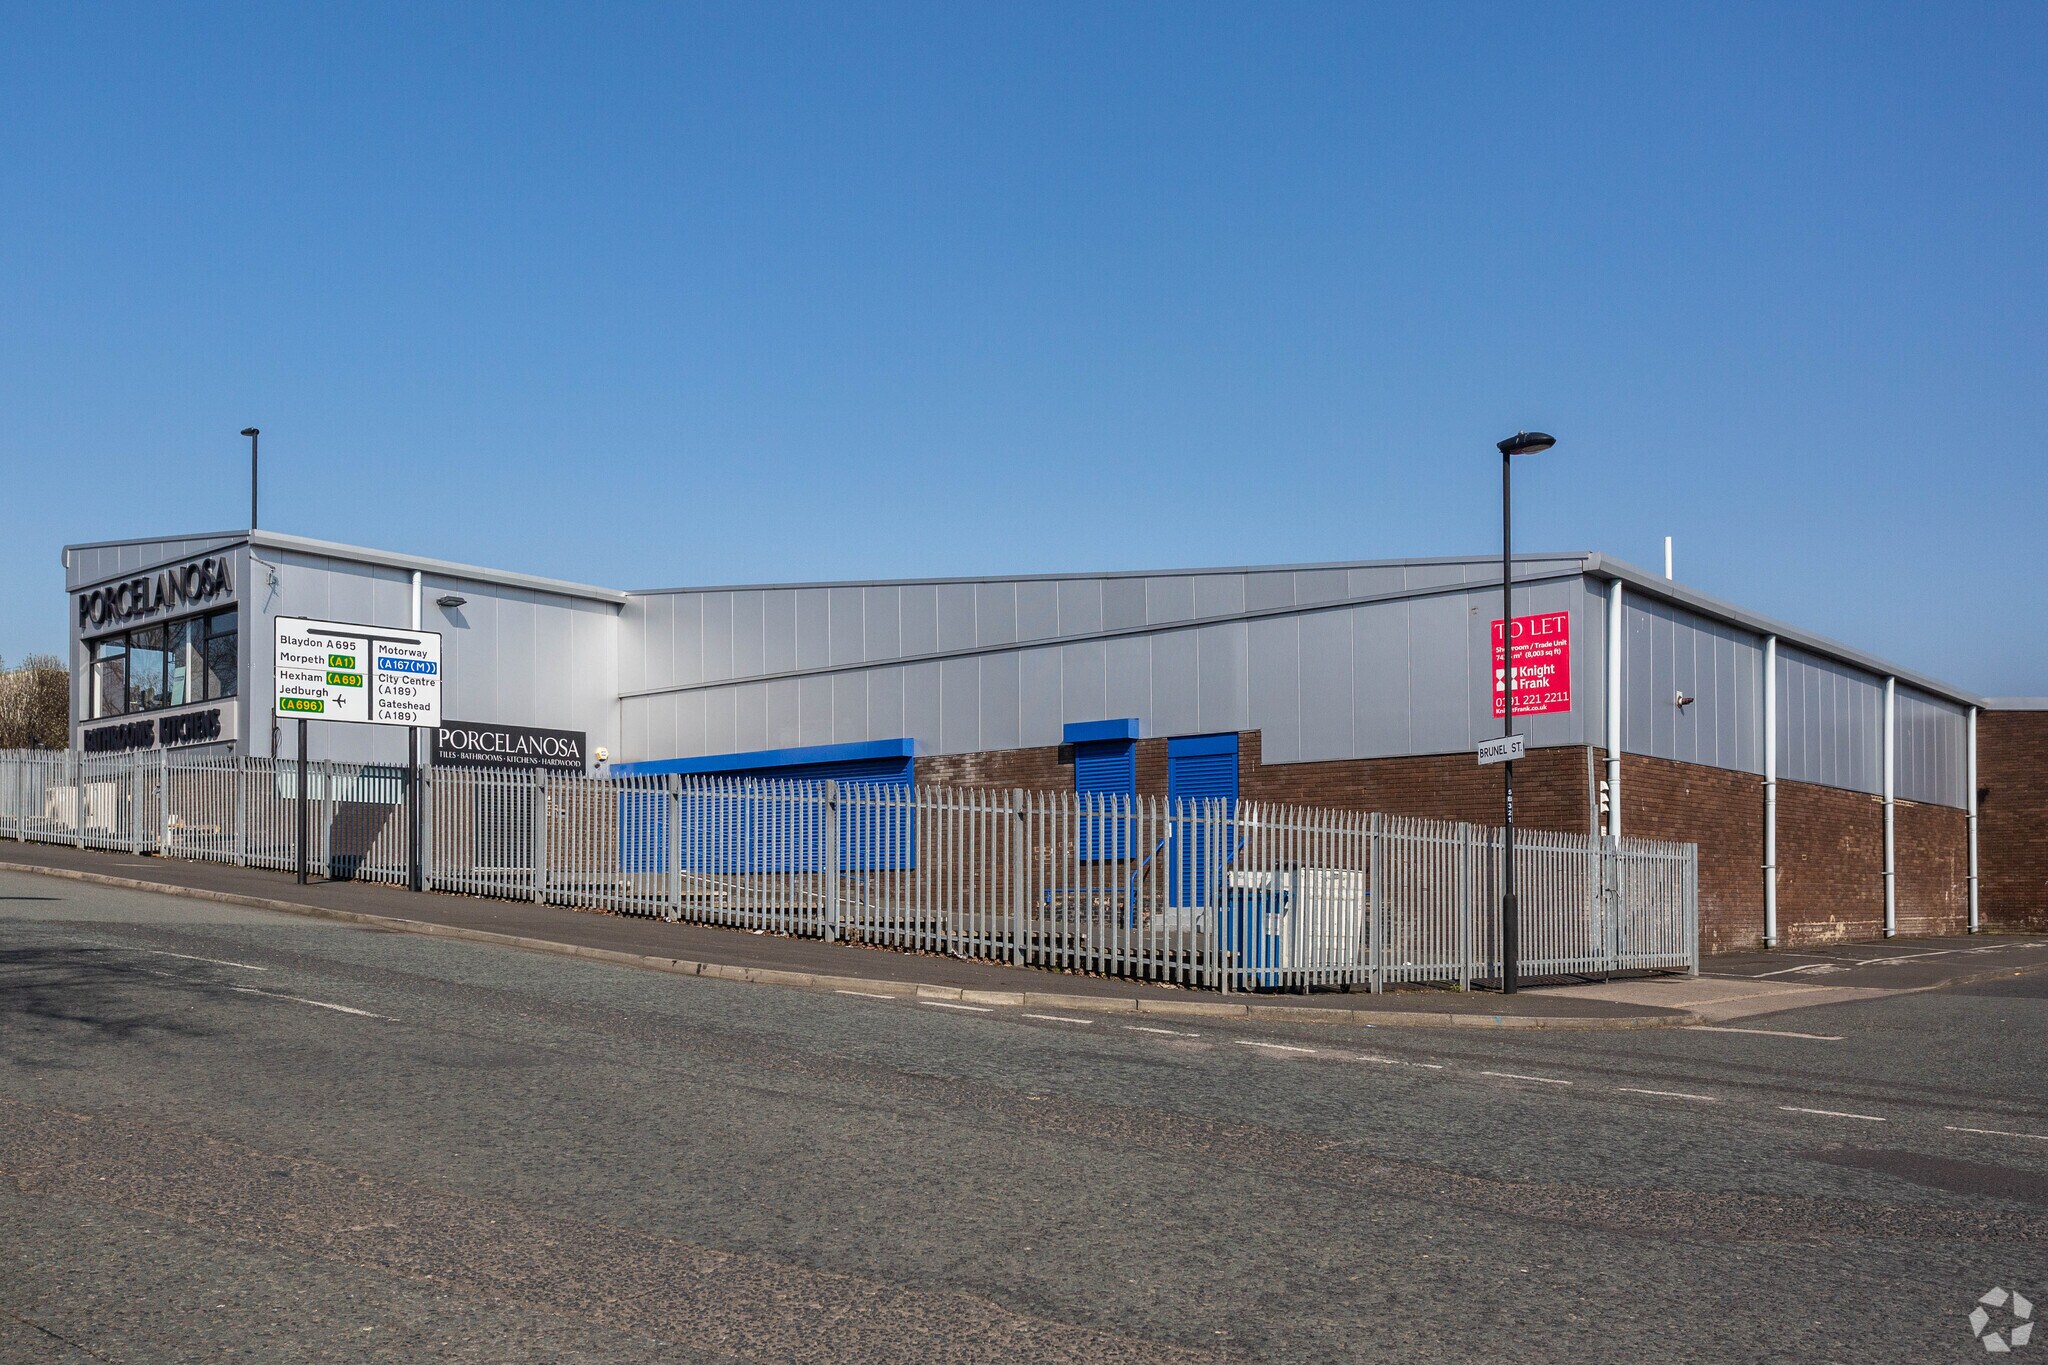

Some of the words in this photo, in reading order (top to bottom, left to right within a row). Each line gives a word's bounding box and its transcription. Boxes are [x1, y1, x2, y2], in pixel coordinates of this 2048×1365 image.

[79, 557, 233, 629] PORCELANOSA
[1494, 622, 1523, 639] TO
[1531, 616, 1566, 636] LET
[280, 636, 322, 648] Blaydon
[379, 645, 427, 658] Motorway
[280, 652, 324, 665] Morpeth
[330, 655, 355, 668] (A1)
[379, 658, 436, 673] (A167(M))
[1520, 664, 1555, 677] Knight
[280, 671, 322, 682] Hexham
[327, 673, 362, 686] (A69)
[379, 674, 399, 685] City
[402, 676, 435, 687] Centre
[1520, 678, 1550, 689] Frank
[280, 685, 328, 698] Jedburgh
[379, 686, 417, 697] (A189)
[1523, 694, 1541, 704] 221
[1545, 692, 1569, 702] 2211
[281, 698, 323, 712] (A696)
[379, 699, 430, 711] Gateshead
[379, 710, 417, 721] (A189)
[159, 709, 221, 745] KITCHENS
[439, 728, 580, 758] PORCELANOSA
[1480, 744, 1507, 758] BRUNEL
[1511, 742, 1522, 753] ST.
[461, 752, 502, 761] BATHROOMS
[506, 756, 538, 764] KITCHENS
[541, 759, 581, 767] HARDWOOD
